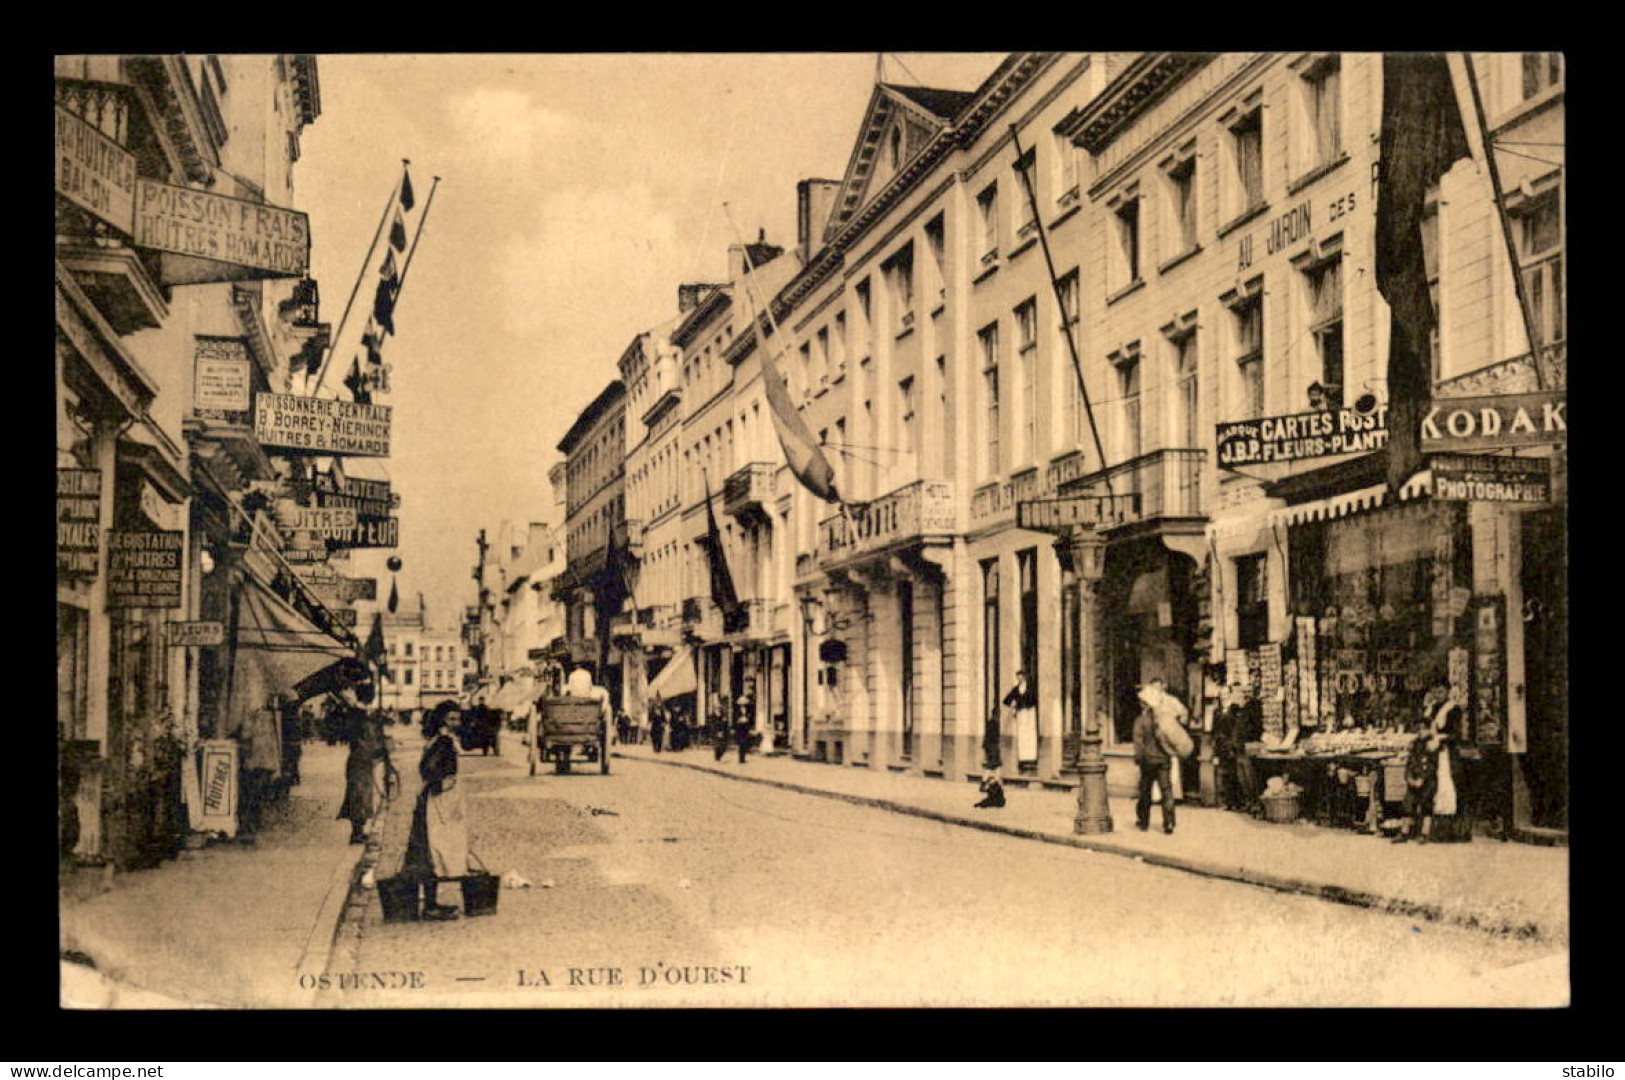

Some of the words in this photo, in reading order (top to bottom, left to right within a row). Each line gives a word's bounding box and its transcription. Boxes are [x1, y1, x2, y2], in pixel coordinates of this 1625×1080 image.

[140, 181, 232, 229] POISSON
[240, 204, 305, 242] FRAIS
[140, 214, 220, 257] HUITRES
[226, 233, 306, 272] HOMARDS
[1237, 232, 1253, 273] AU
[1266, 199, 1312, 256] JARDIN
[1329, 191, 1356, 222] DES
[259, 393, 333, 416] POISSONNERIE
[338, 402, 392, 423] CENTRALE
[1421, 402, 1567, 439] KODAK
[257, 428, 312, 446] HUITRES
[331, 434, 389, 454] HOMARDS
[1260, 411, 1334, 441] CARTES
[1220, 439, 1261, 464] J.B.P.
[1436, 478, 1547, 500] PHOTOGRAPHIE
[293, 509, 355, 529] UITRES
